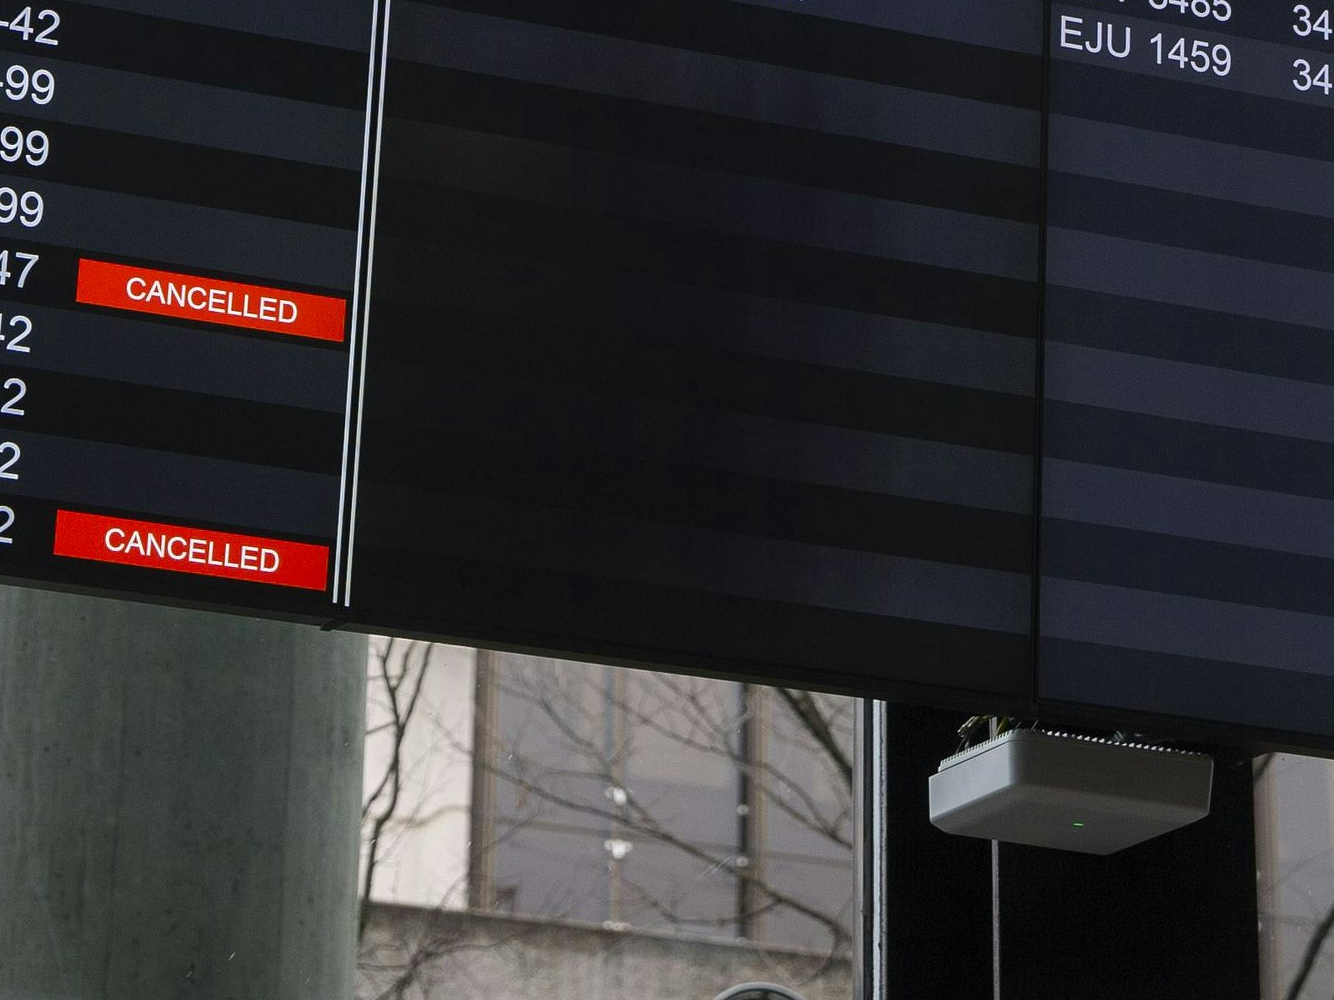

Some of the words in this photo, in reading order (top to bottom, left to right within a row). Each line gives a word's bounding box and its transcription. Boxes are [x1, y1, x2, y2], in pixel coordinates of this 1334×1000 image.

[1061, 16, 1130, 57] EJU
[1151, 33, 1231, 76] 1459
[127, 277, 297, 323] CANCELLED
[105, 528, 279, 572] CANCELLED
